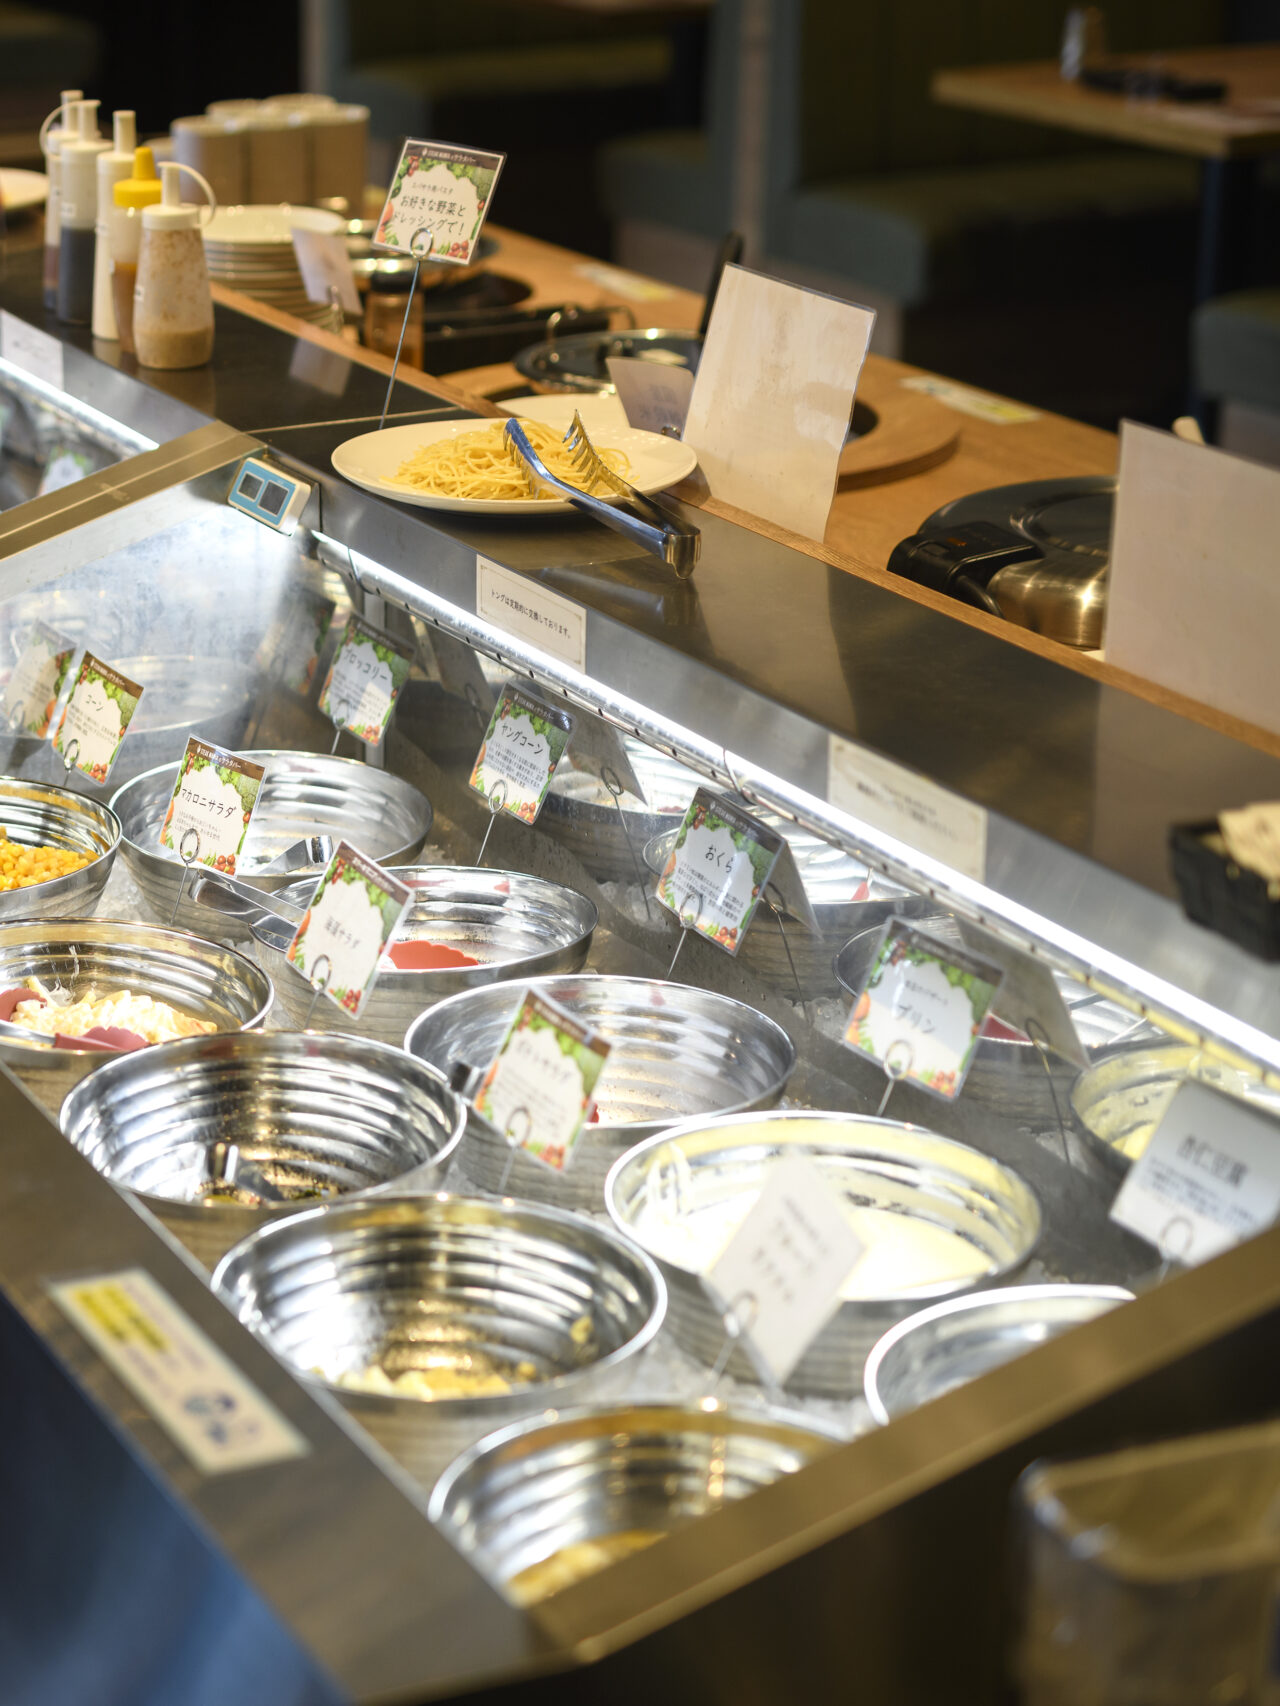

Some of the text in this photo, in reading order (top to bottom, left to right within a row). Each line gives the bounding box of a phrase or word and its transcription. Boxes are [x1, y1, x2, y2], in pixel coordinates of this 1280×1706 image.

[400, 195, 468, 217] お好きな野菜と
[491, 588, 573, 639] トングは定期的に交換しております。
[343, 647, 389, 682] ブロッコリー
[84, 694, 104, 712] コーン
[500, 723, 545, 755] ヤングコーン
[181, 787, 238, 819] マカロニサラダ
[704, 844, 735, 874] おくら
[896, 1004, 938, 1035] プリン
